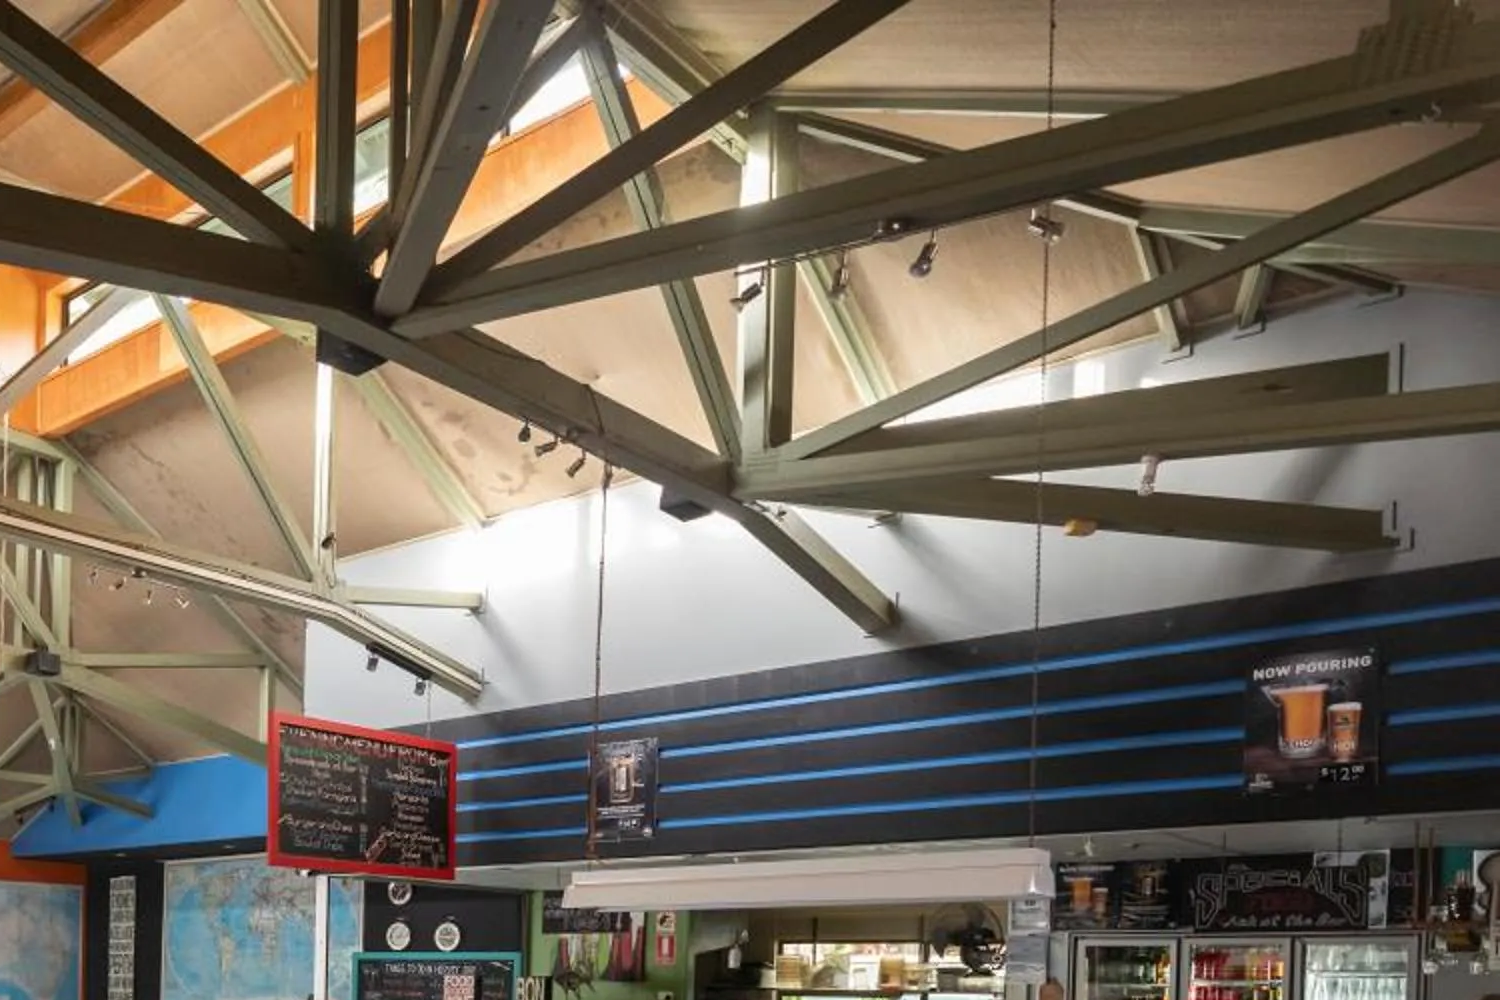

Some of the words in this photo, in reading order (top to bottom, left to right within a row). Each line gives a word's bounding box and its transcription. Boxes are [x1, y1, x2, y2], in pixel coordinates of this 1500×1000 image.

[1252, 663, 1292, 681] NOW
[1294, 655, 1373, 675] POURING
[1195, 867, 1368, 930] SPECIALS
[444, 975, 475, 987] FOOD
